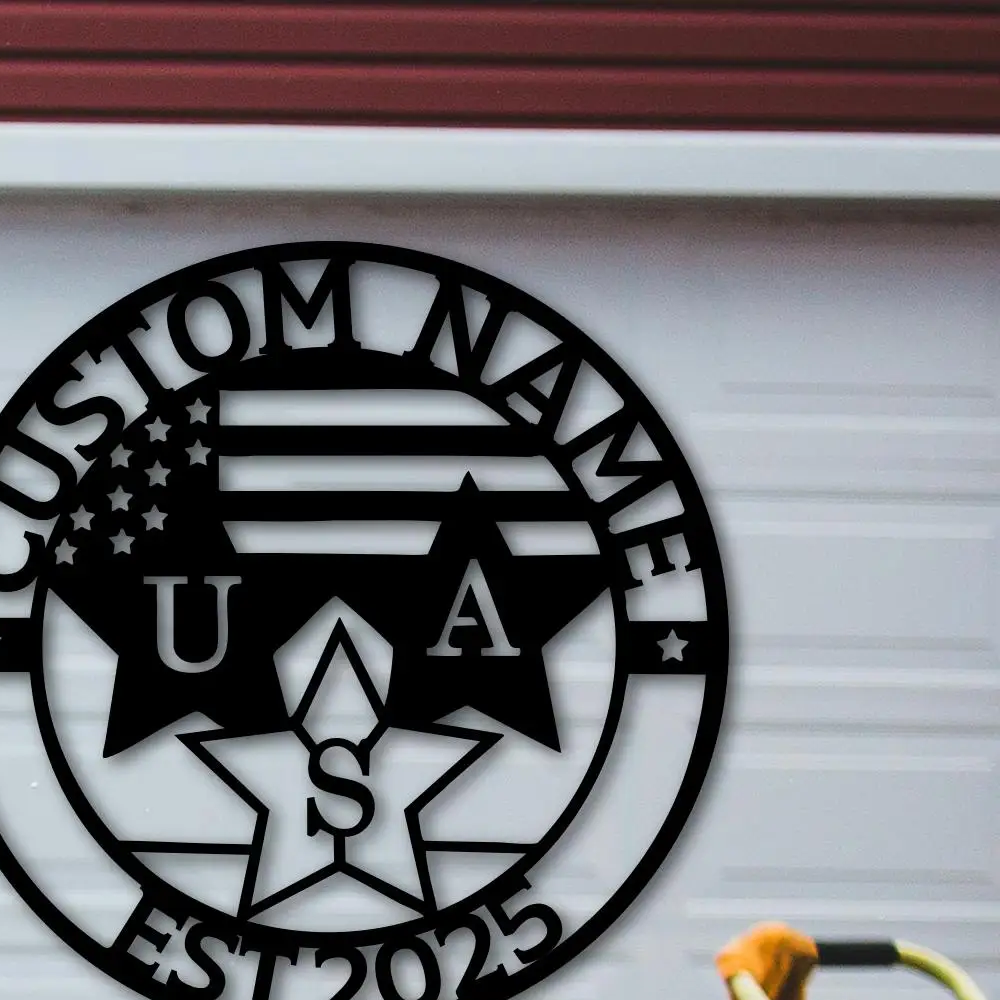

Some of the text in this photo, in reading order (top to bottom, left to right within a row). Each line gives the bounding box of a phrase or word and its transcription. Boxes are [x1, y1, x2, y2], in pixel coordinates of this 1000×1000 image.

[402, 275, 698, 591] NAME
[143, 575, 243, 674] U
[426, 558, 521, 657] A
[306, 737, 376, 838] S
